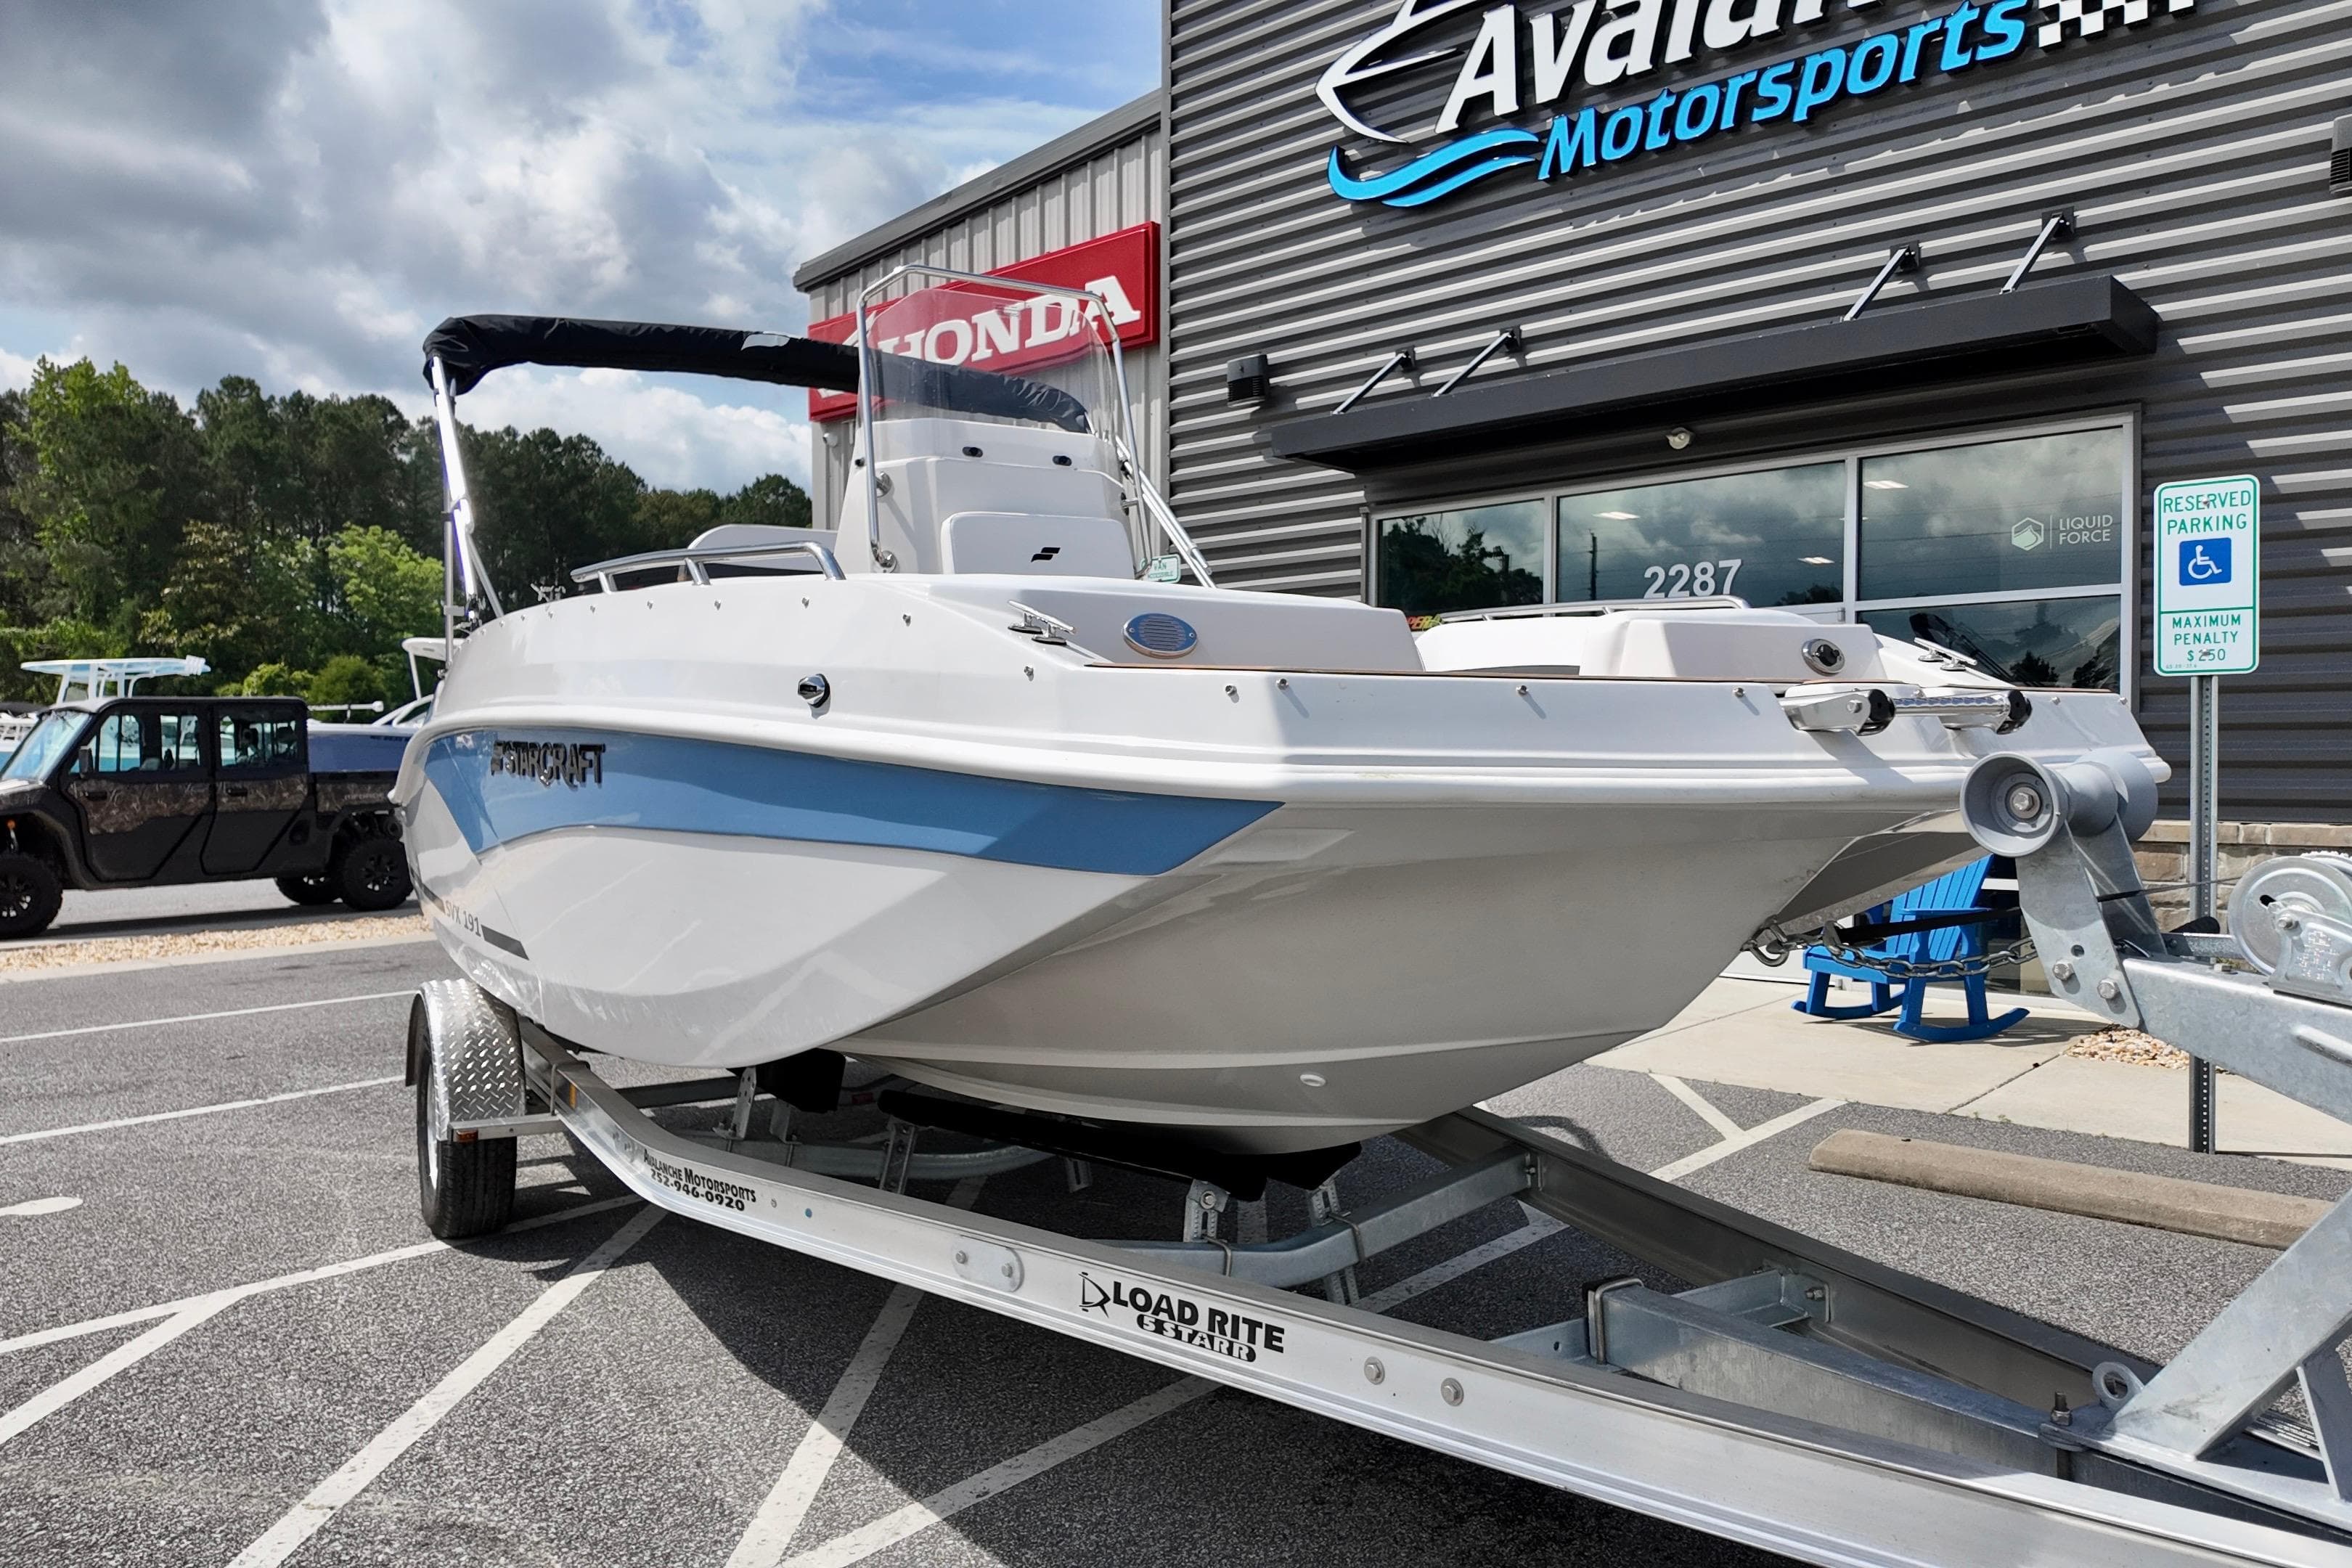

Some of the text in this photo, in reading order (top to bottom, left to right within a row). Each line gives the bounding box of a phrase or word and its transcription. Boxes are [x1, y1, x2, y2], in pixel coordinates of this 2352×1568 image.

[1538, 0, 2028, 181] Motorsports
[2163, 490, 2251, 513] RESERVED
[2059, 514, 2113, 531] LIQUID
[2059, 529, 2111, 545] FORCE
[2167, 513, 2248, 535] PARKING
[1643, 558, 1742, 599] 2287
[2171, 614, 2242, 629] MAXIMUM
[2173, 631, 2239, 646] PENALTY
[502, 740, 605, 791] STARCRAFT
[445, 899, 481, 937] SVX 191
[650, 1168, 745, 1212] 252-946-0920
[684, 1167, 756, 1203] MOTORSPORTS
[1113, 1280, 1286, 1354] LOAD RITE
[1142, 1316, 1156, 1332] 5
